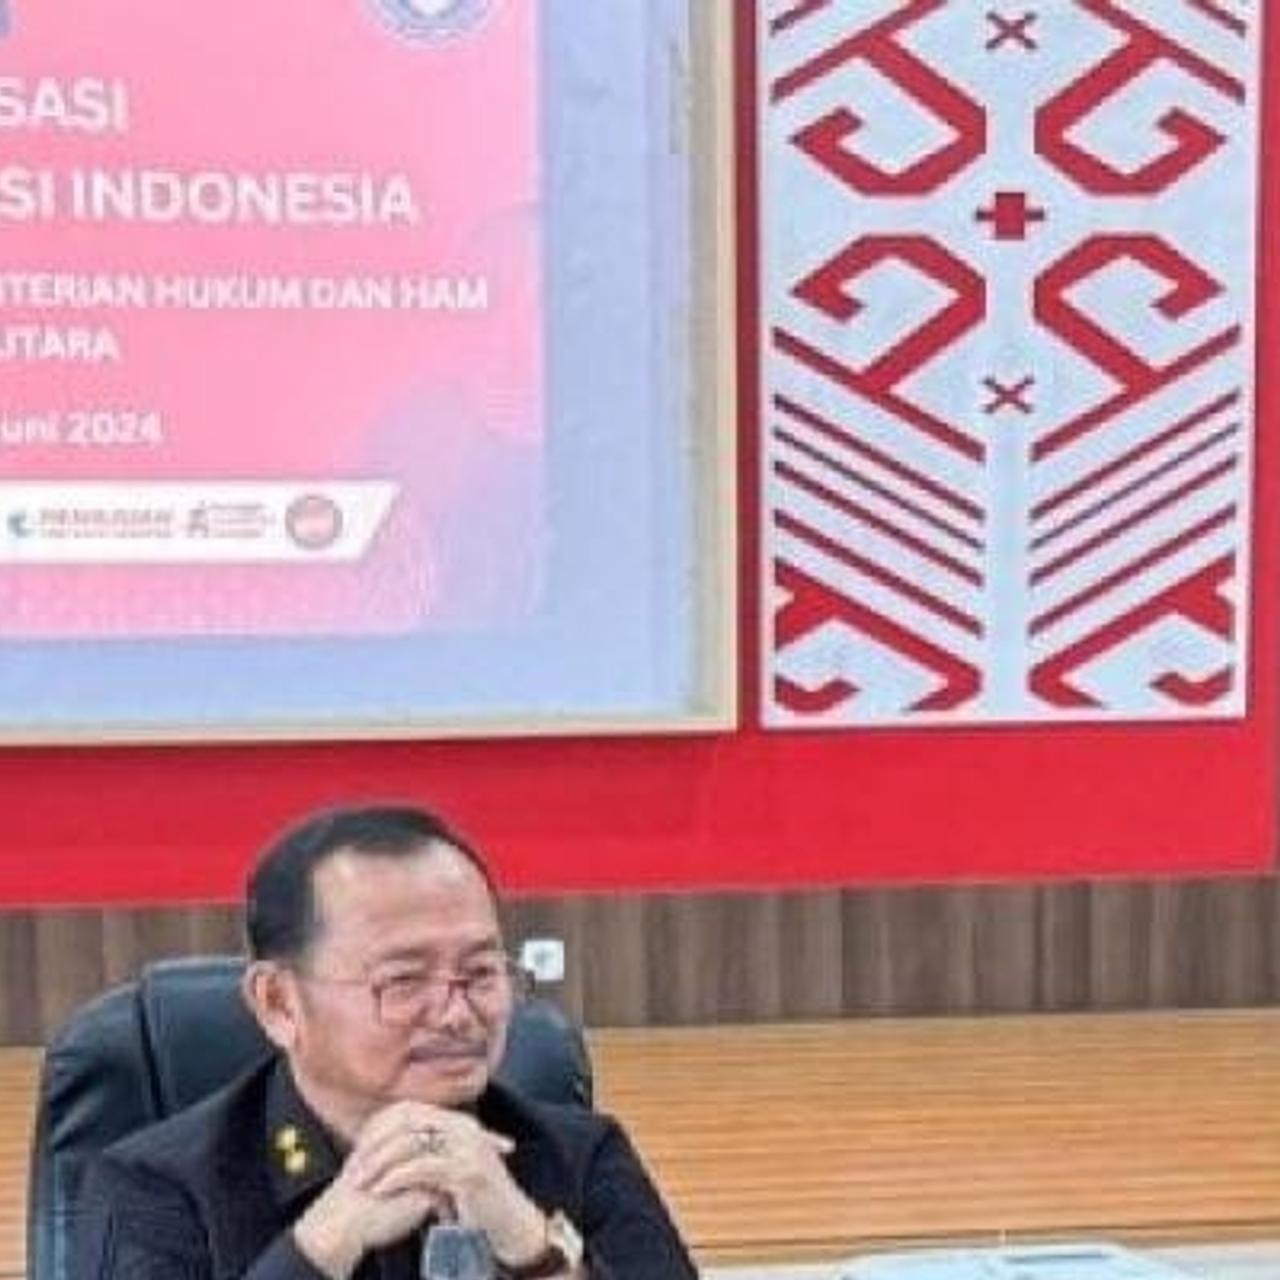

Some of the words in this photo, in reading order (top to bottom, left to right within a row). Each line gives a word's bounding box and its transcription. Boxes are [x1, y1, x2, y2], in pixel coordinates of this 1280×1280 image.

[72, 169, 420, 226] INDONESIA
[154, 274, 304, 309] HUKUM
[312, 276, 394, 310] DAN
[400, 276, 489, 310] HAM
[71, 411, 163, 446] 2024
